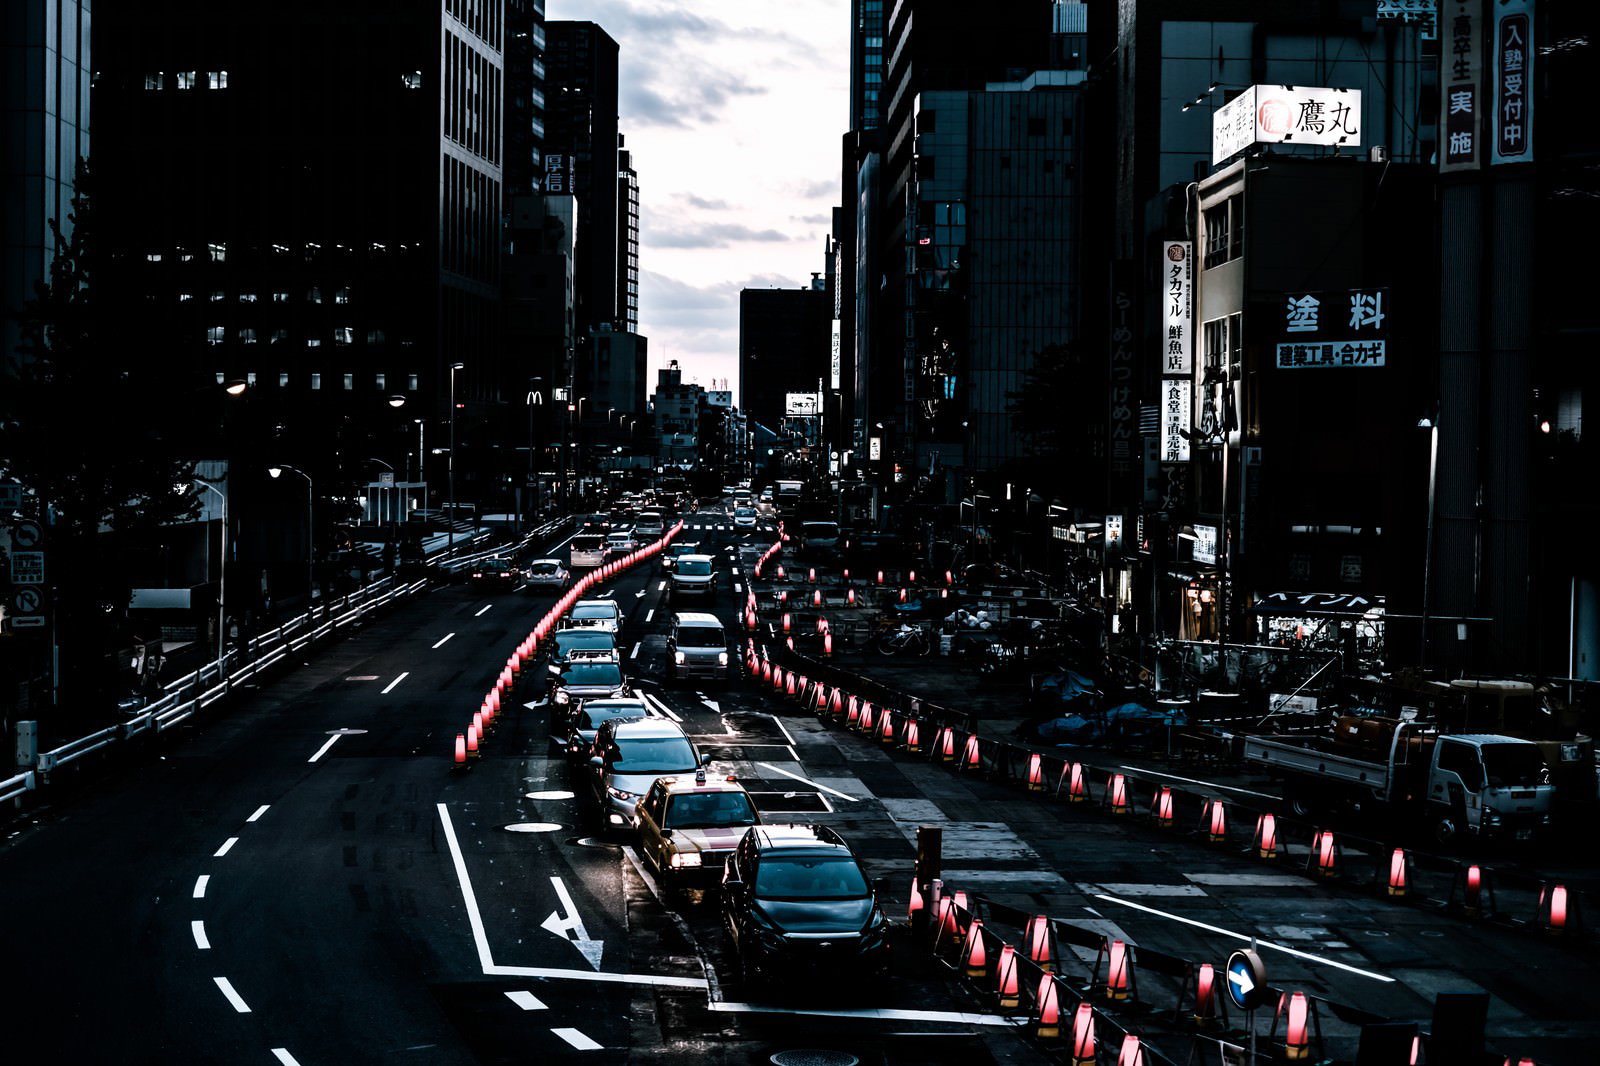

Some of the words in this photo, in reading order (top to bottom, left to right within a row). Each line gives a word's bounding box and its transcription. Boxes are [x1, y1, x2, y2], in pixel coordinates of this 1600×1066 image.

[1504, 25, 1524, 146] 入塾受付中
[1296, 99, 1358, 135] 鷹丸
[1449, 91, 1473, 155] 実施
[1169, 264, 1183, 317] タカマル
[1286, 291, 1386, 333] 塗料
[1168, 325, 1183, 370] 鮮魚店
[1168, 387, 1180, 413] 食堂
[1167, 423, 1180, 462] 直売所
